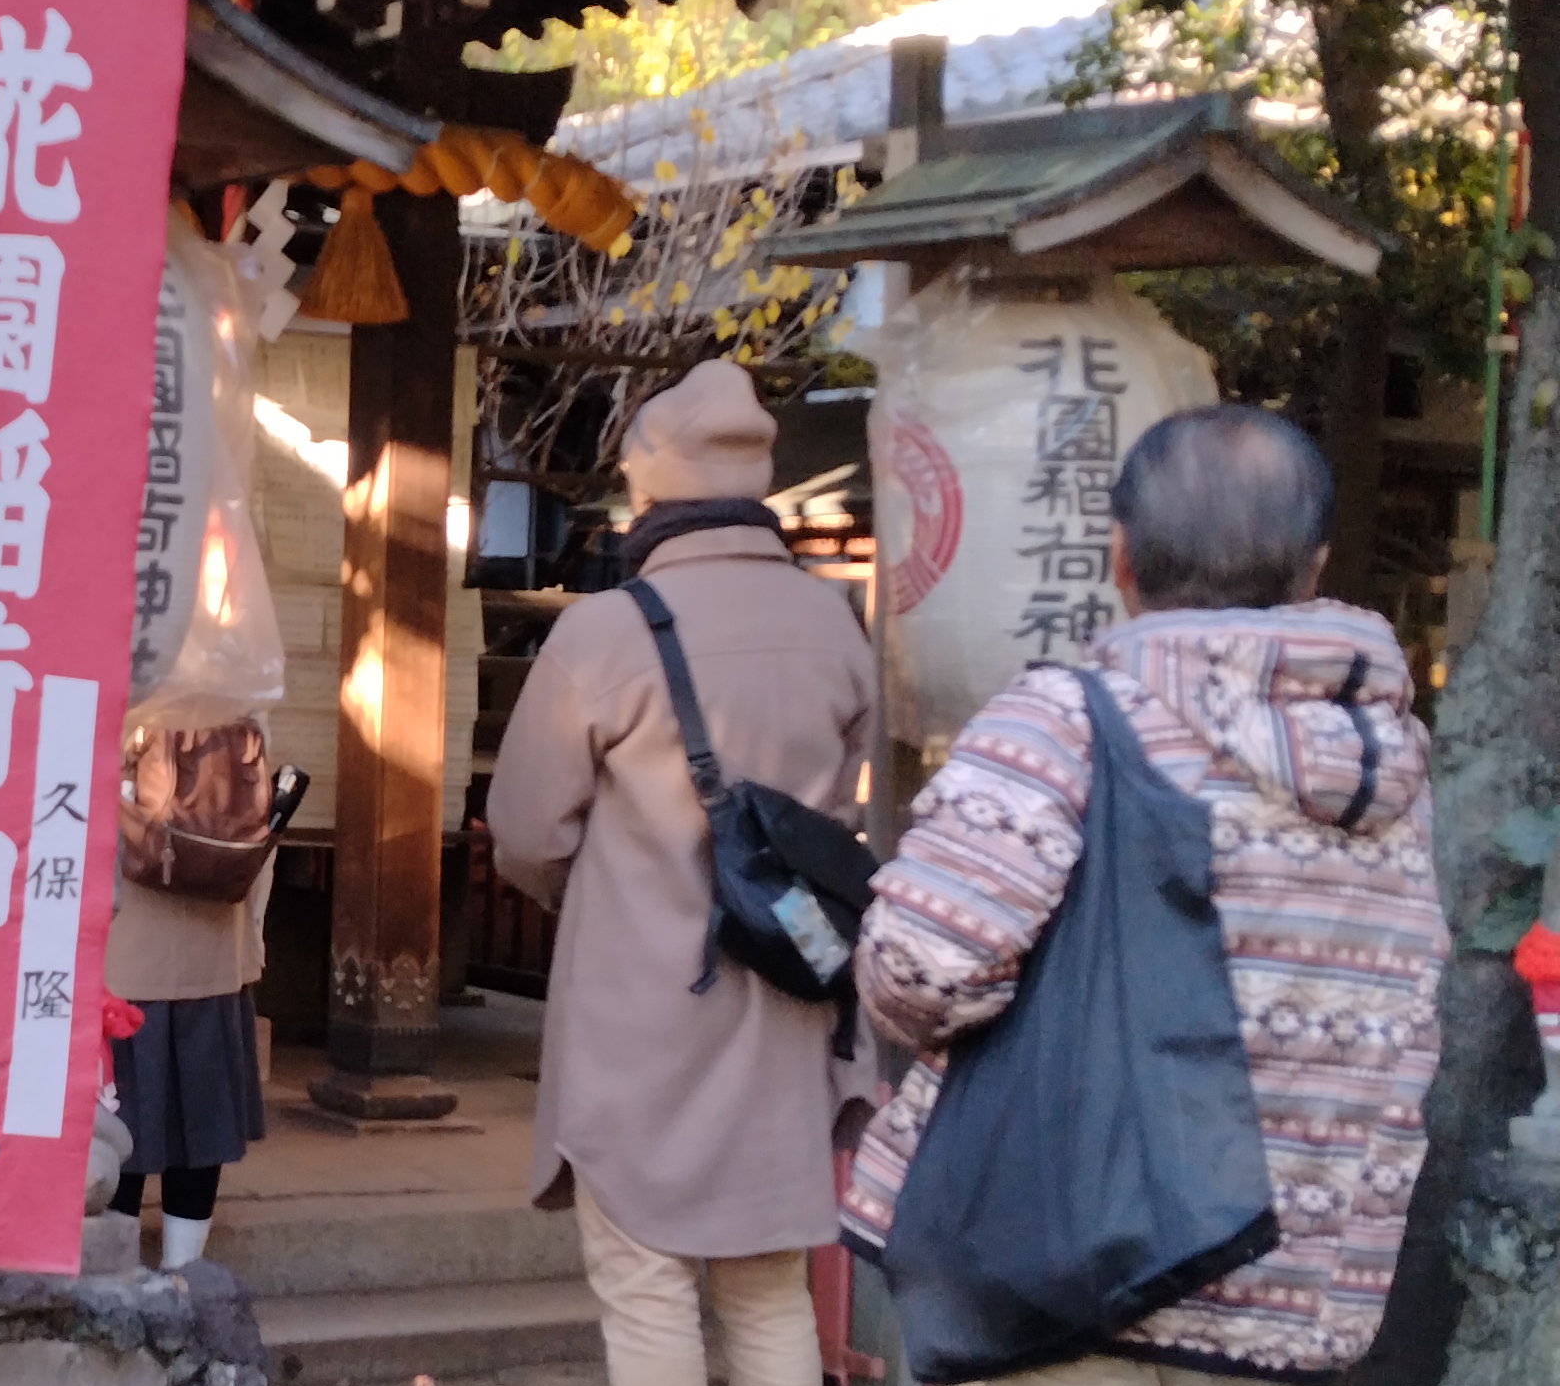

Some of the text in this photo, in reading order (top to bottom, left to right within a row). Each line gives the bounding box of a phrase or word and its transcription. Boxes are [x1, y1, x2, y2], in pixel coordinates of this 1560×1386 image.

[1013, 335, 1127, 669] 花園稲荷神
[24, 782, 87, 1021] 久保隆
